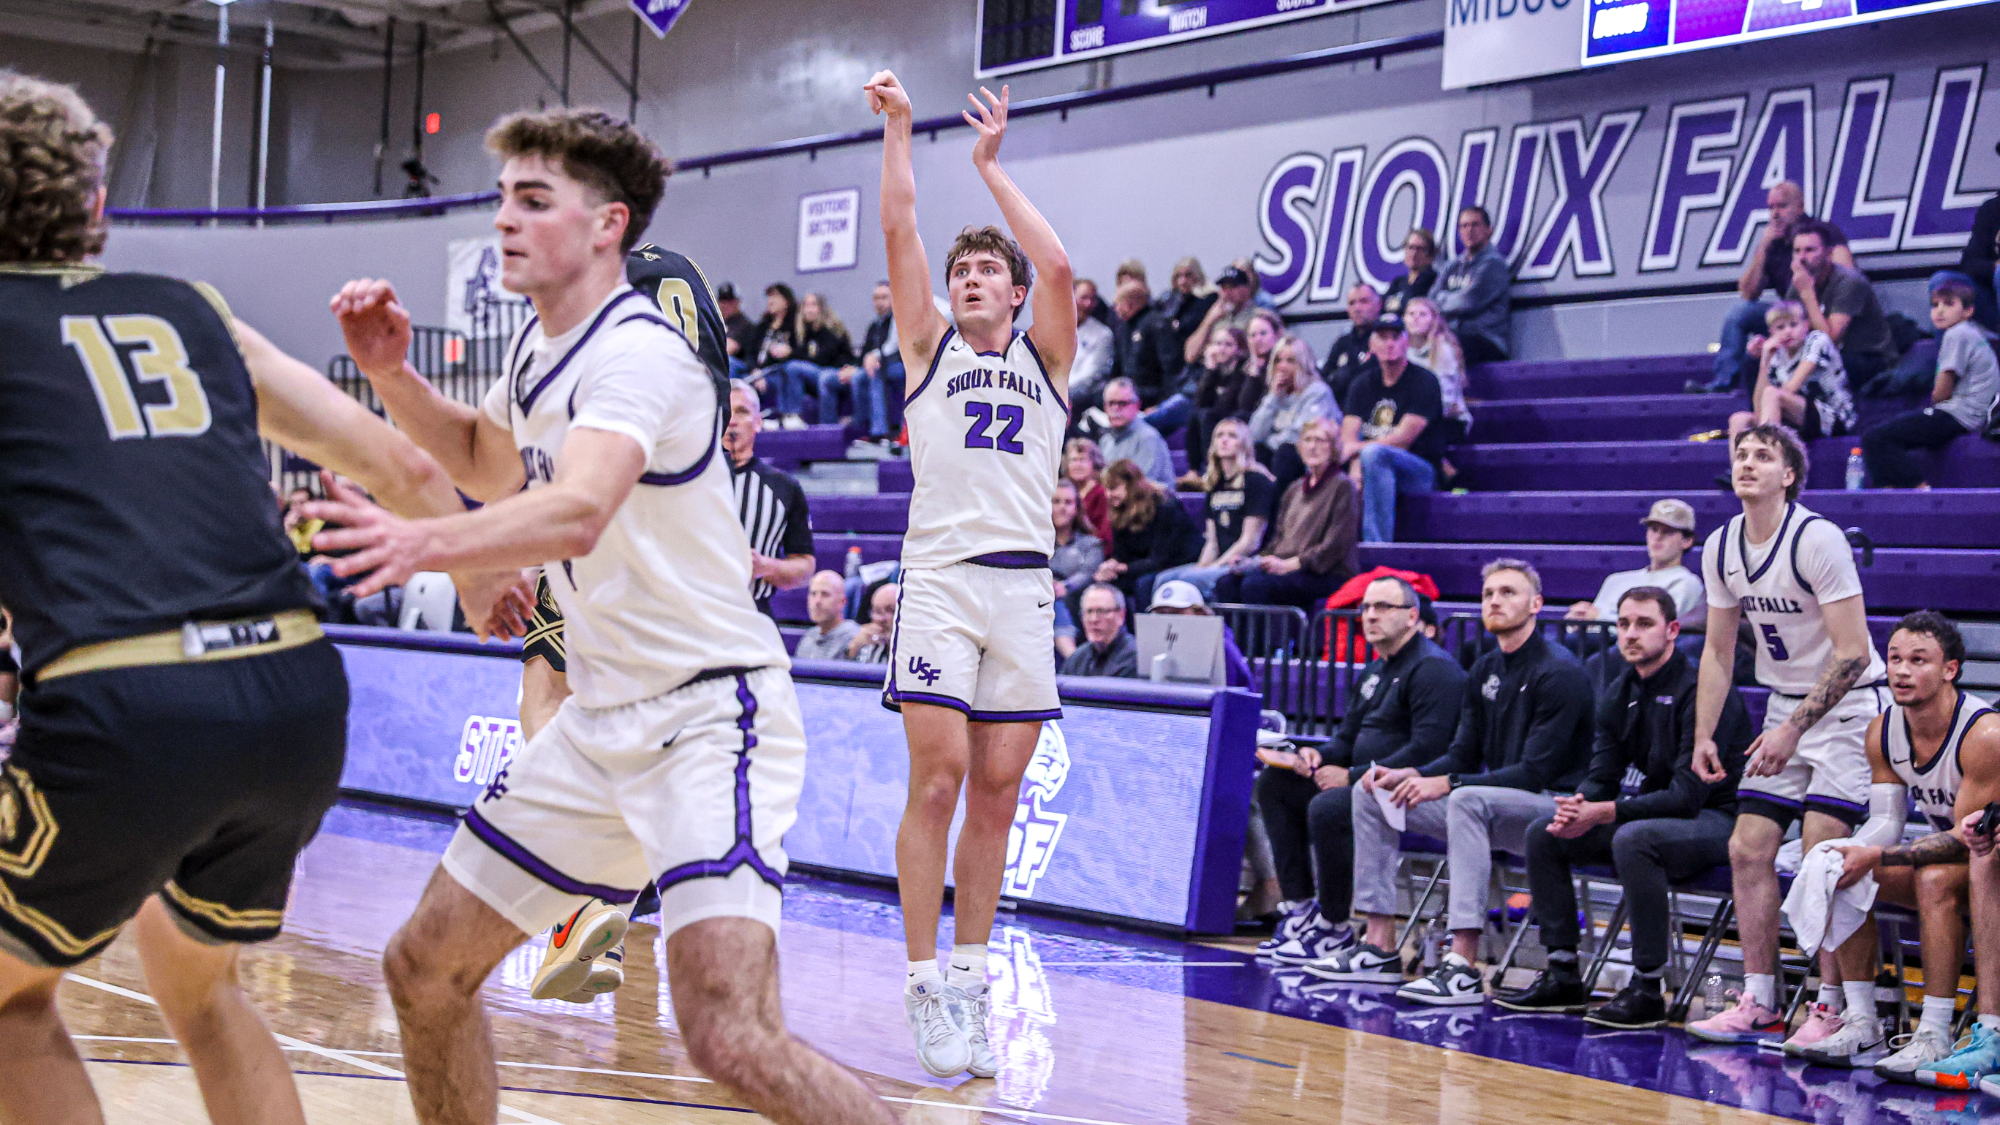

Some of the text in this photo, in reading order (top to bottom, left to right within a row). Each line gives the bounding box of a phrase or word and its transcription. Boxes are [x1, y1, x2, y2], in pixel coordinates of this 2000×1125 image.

[1070, 25, 1105, 51] SCORE
[1253, 106, 1647, 308] SIOUX
[60, 314, 213, 441] 13
[947, 368, 1042, 405] SIOUX FALLS
[964, 400, 1025, 455] 22
[1759, 623, 1790, 661] 5
[908, 656, 942, 687] USF
